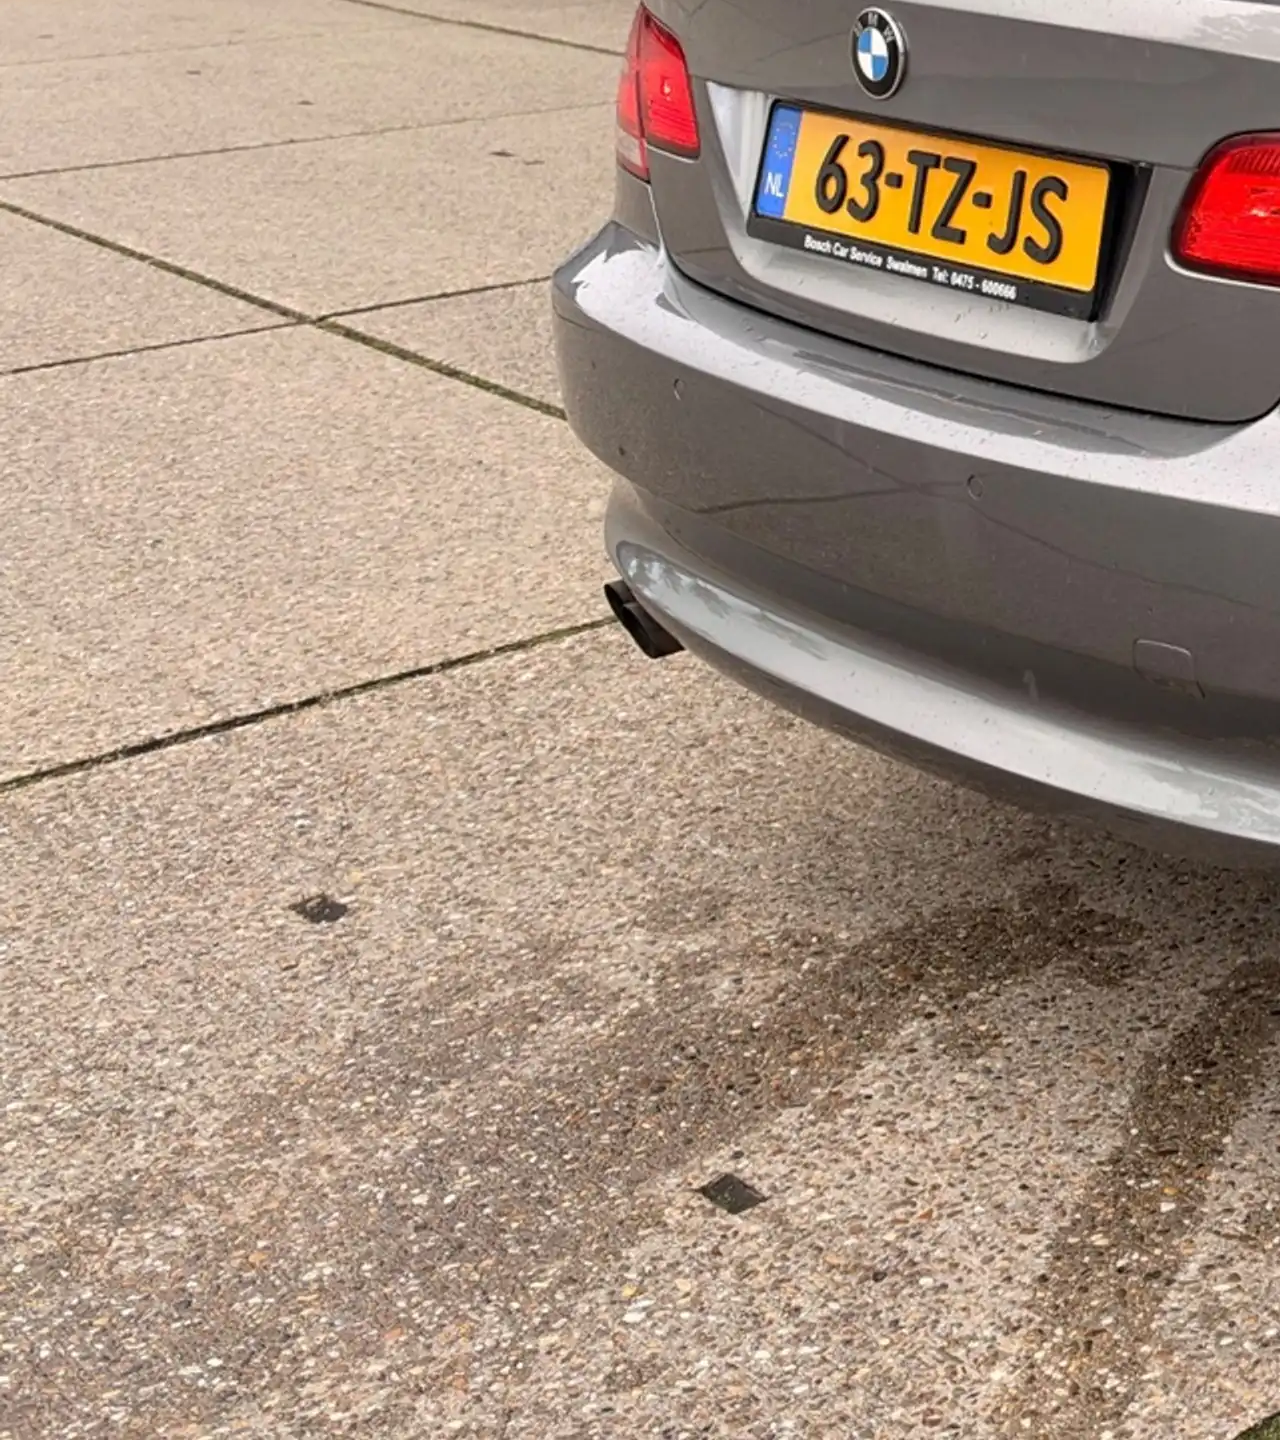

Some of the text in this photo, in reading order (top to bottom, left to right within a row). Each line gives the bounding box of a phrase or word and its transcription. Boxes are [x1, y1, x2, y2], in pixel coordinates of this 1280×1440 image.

[853, 12, 896, 44] BMW
[764, 172, 785, 198] NL
[815, 134, 1069, 264] 63-TZ-JS
[804, 234, 832, 253] Bosch
[832, 242, 849, 258] Car
[850, 246, 883, 267] Service
